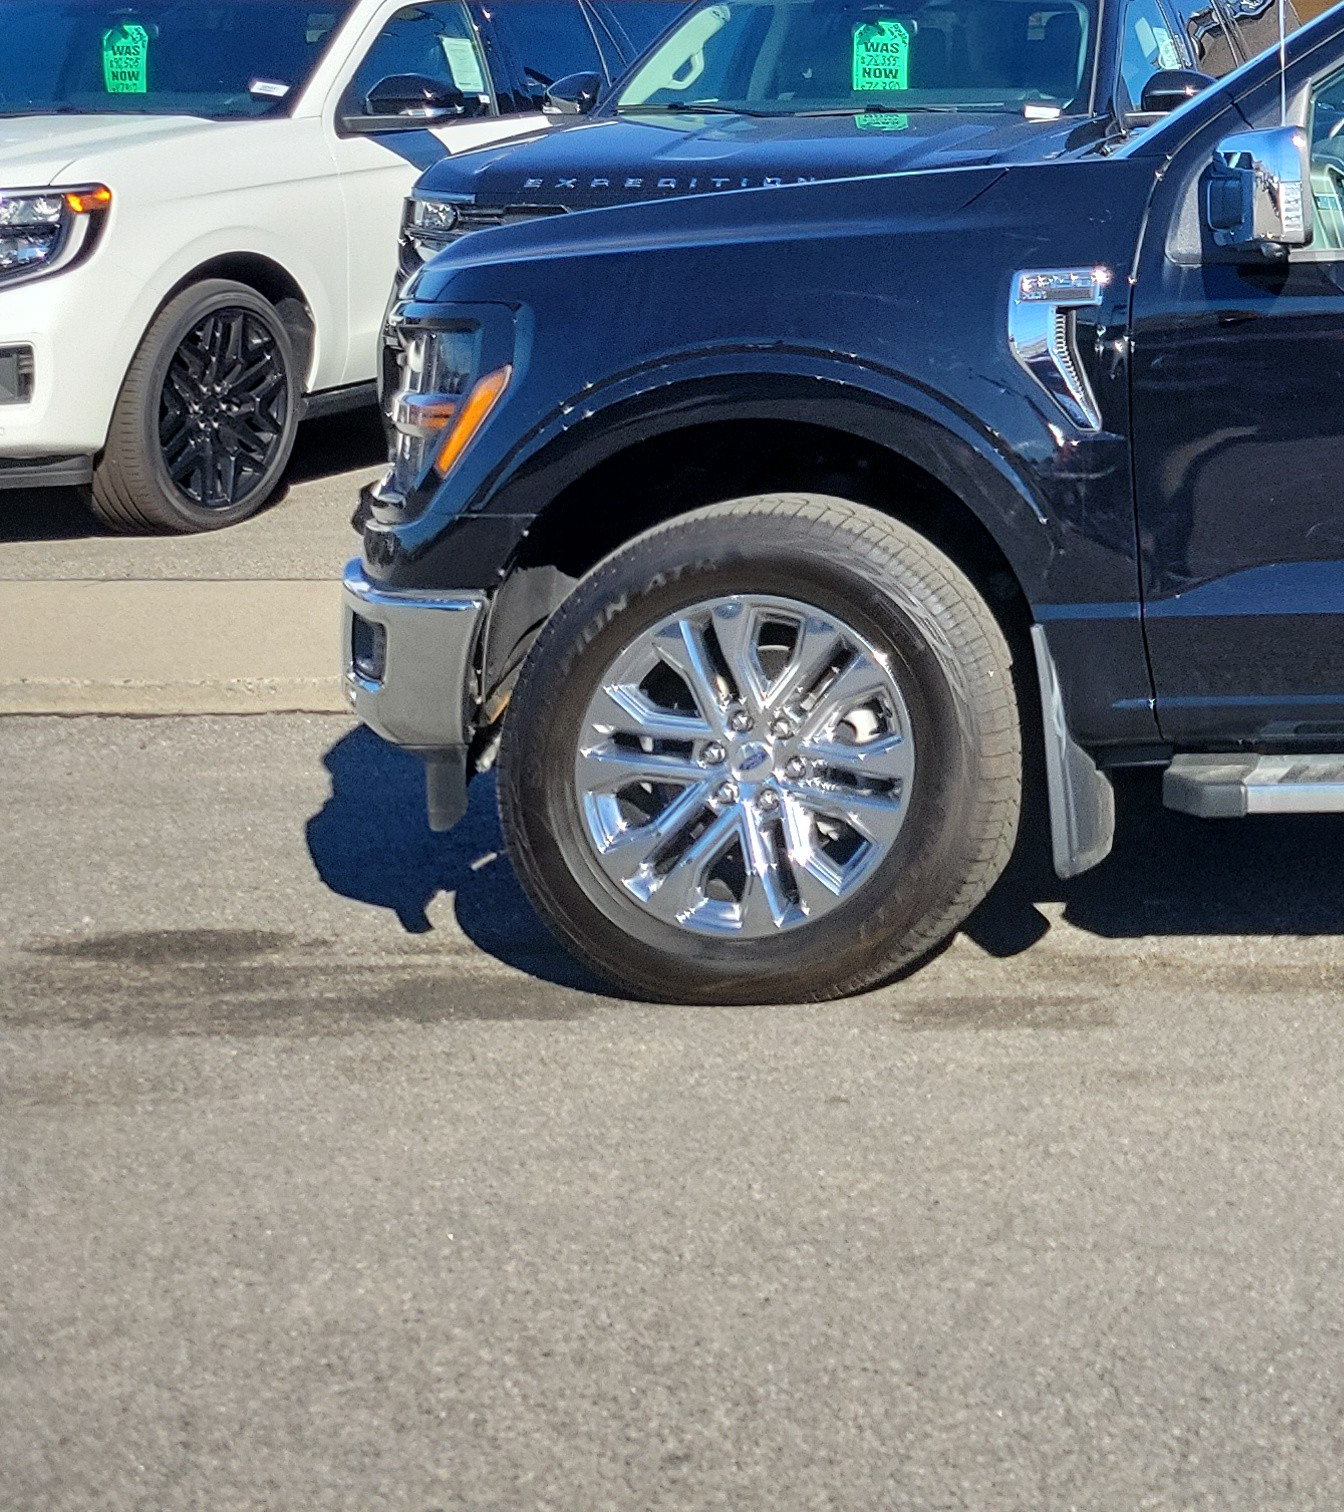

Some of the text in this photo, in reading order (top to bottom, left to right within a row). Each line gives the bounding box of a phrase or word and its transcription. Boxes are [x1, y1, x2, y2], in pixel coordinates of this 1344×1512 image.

[112, 45, 140, 56] WAS
[864, 42, 900, 54] WAS
[111, 70, 140, 81] NOW
[862, 68, 898, 79] NOW
